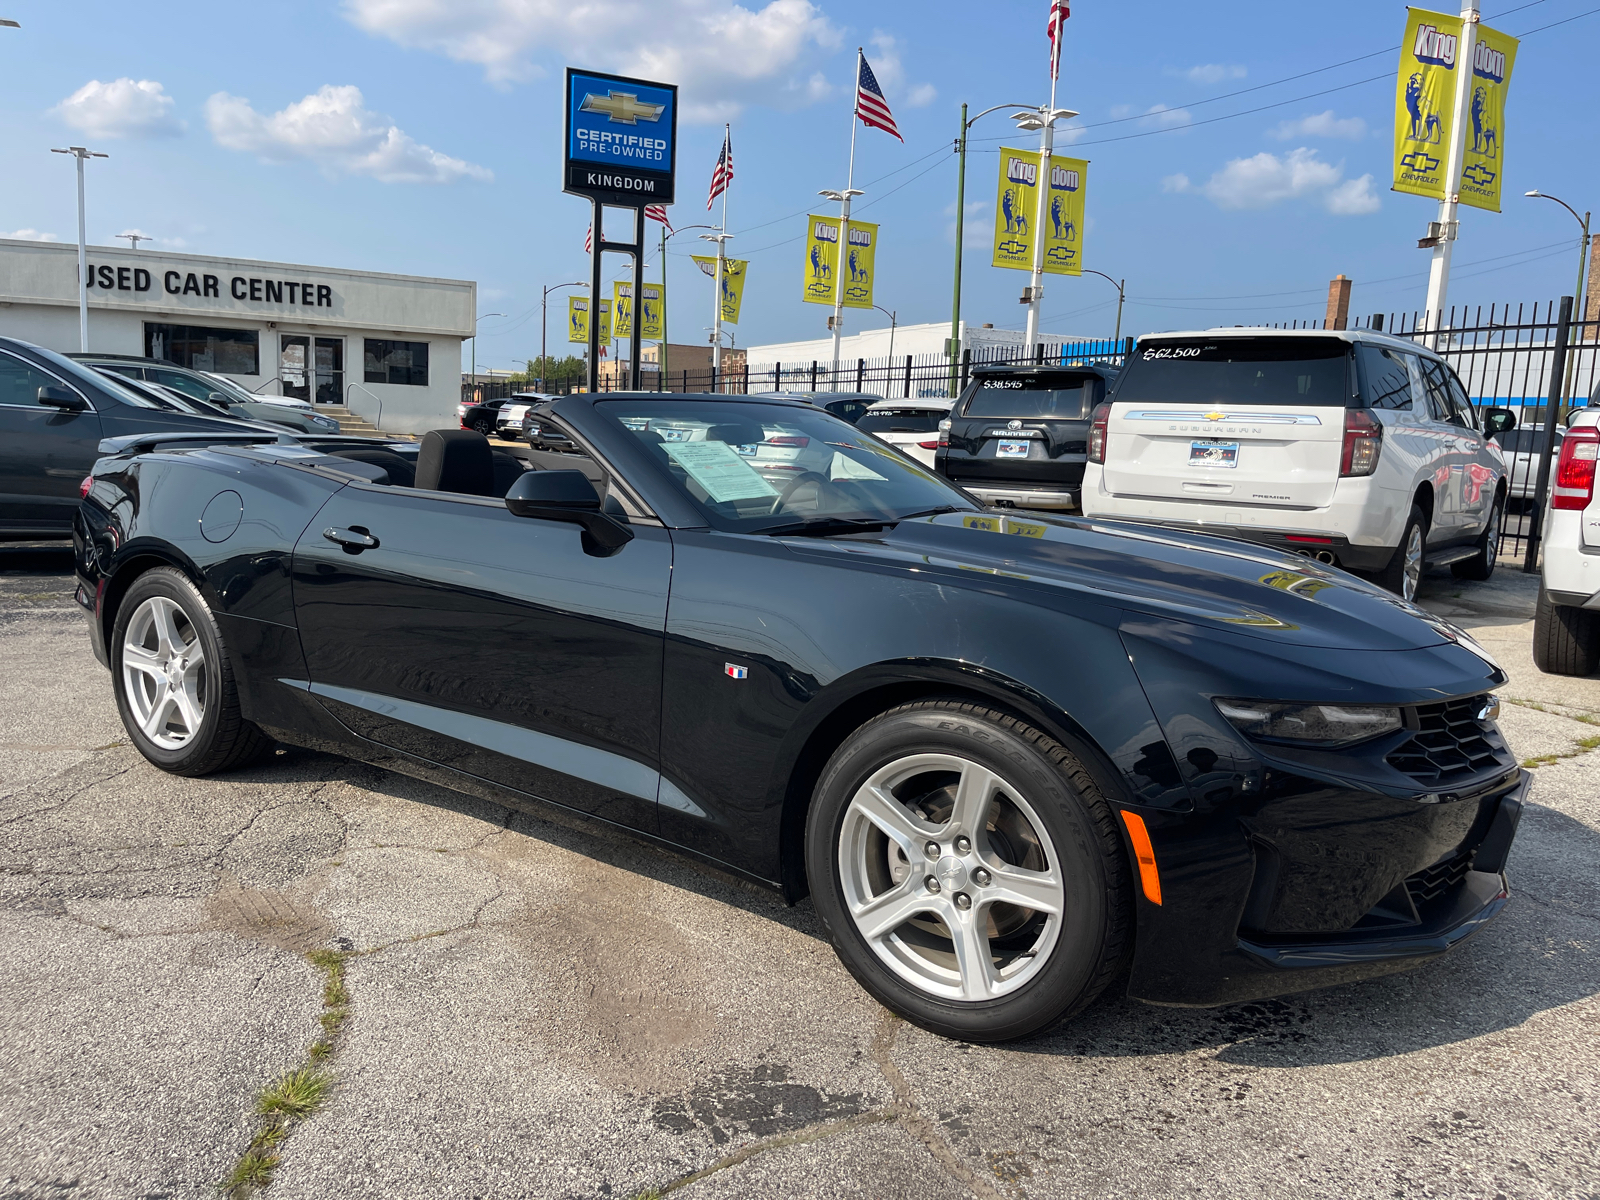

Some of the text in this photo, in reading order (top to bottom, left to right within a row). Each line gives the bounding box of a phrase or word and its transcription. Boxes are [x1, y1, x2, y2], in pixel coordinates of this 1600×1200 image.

[1413, 24, 1506, 81] King dom
[576, 128, 666, 150] CERTIFIED
[580, 140, 663, 161] PRE-OWNED
[587, 172, 655, 192] KINGDOM
[1007, 157, 1079, 189] King dom
[1401, 172, 1439, 184] CHEVROLET
[1461, 183, 1495, 197] CHEVROLET
[814, 222, 871, 245] King dom
[1047, 259, 1077, 267] CHEVROLET
[164, 270, 219, 298] CAR
[231, 276, 332, 308] CENTER
[1143, 347, 1201, 361] $62,500
[1169, 425, 1262, 434] SUBURBAN
[936, 721, 1090, 857] EAGLE SPORT
